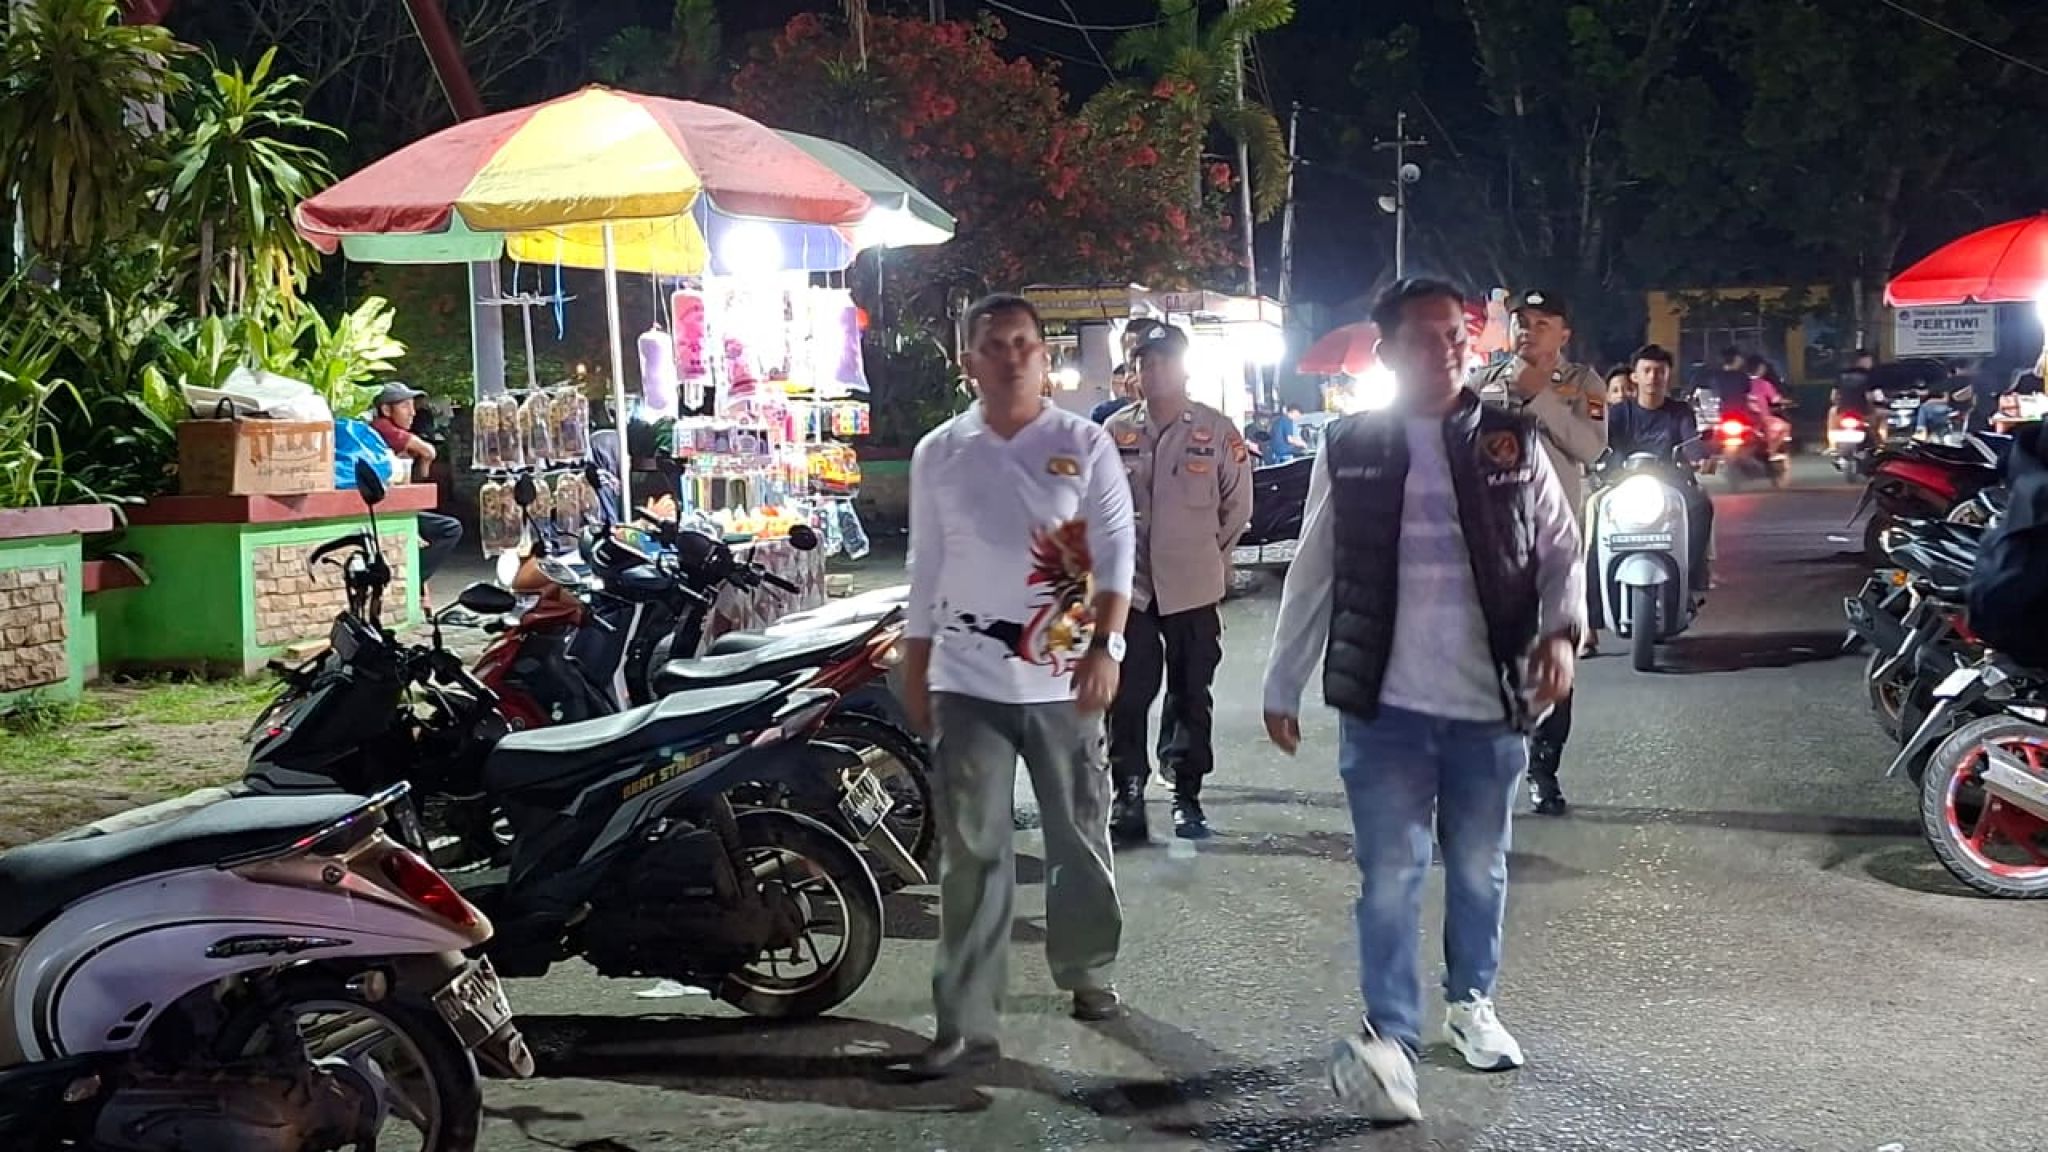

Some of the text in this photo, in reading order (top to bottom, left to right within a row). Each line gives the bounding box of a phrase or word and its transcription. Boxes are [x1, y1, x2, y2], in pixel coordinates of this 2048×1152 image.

[1913, 318, 1979, 329] PERTIWI
[622, 747, 713, 800] BEAT STREET
